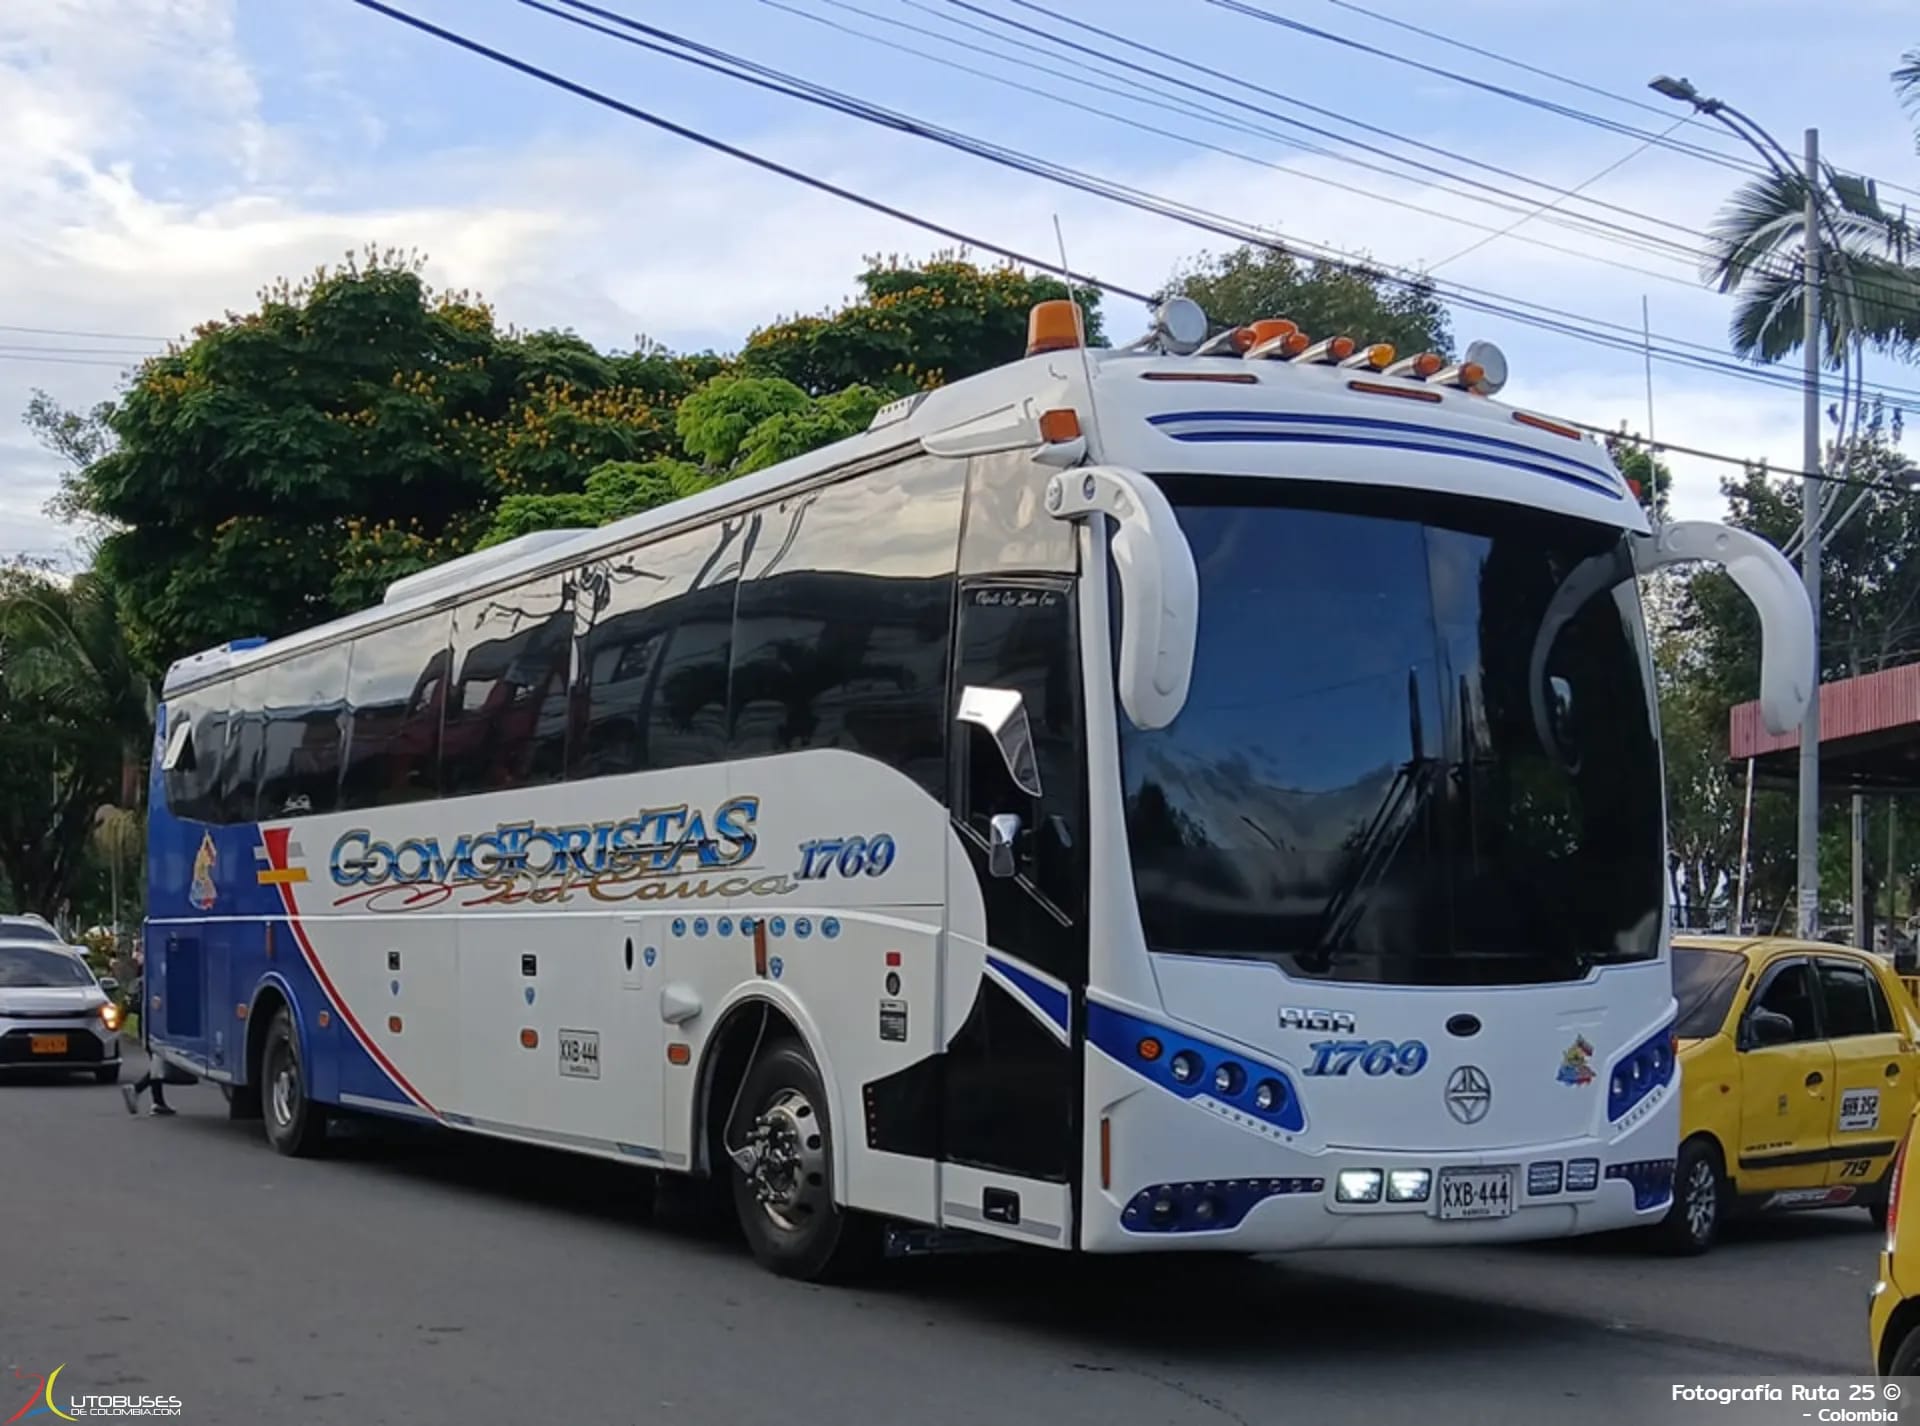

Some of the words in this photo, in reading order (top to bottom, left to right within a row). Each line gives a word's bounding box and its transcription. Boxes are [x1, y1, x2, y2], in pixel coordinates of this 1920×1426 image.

[794, 833, 896, 880] 1769
[588, 851, 798, 902] Cauca
[1279, 1007, 1355, 1034] AGA
[1302, 1039, 1429, 1077] 1769
[1840, 1160, 1871, 1177] 719
